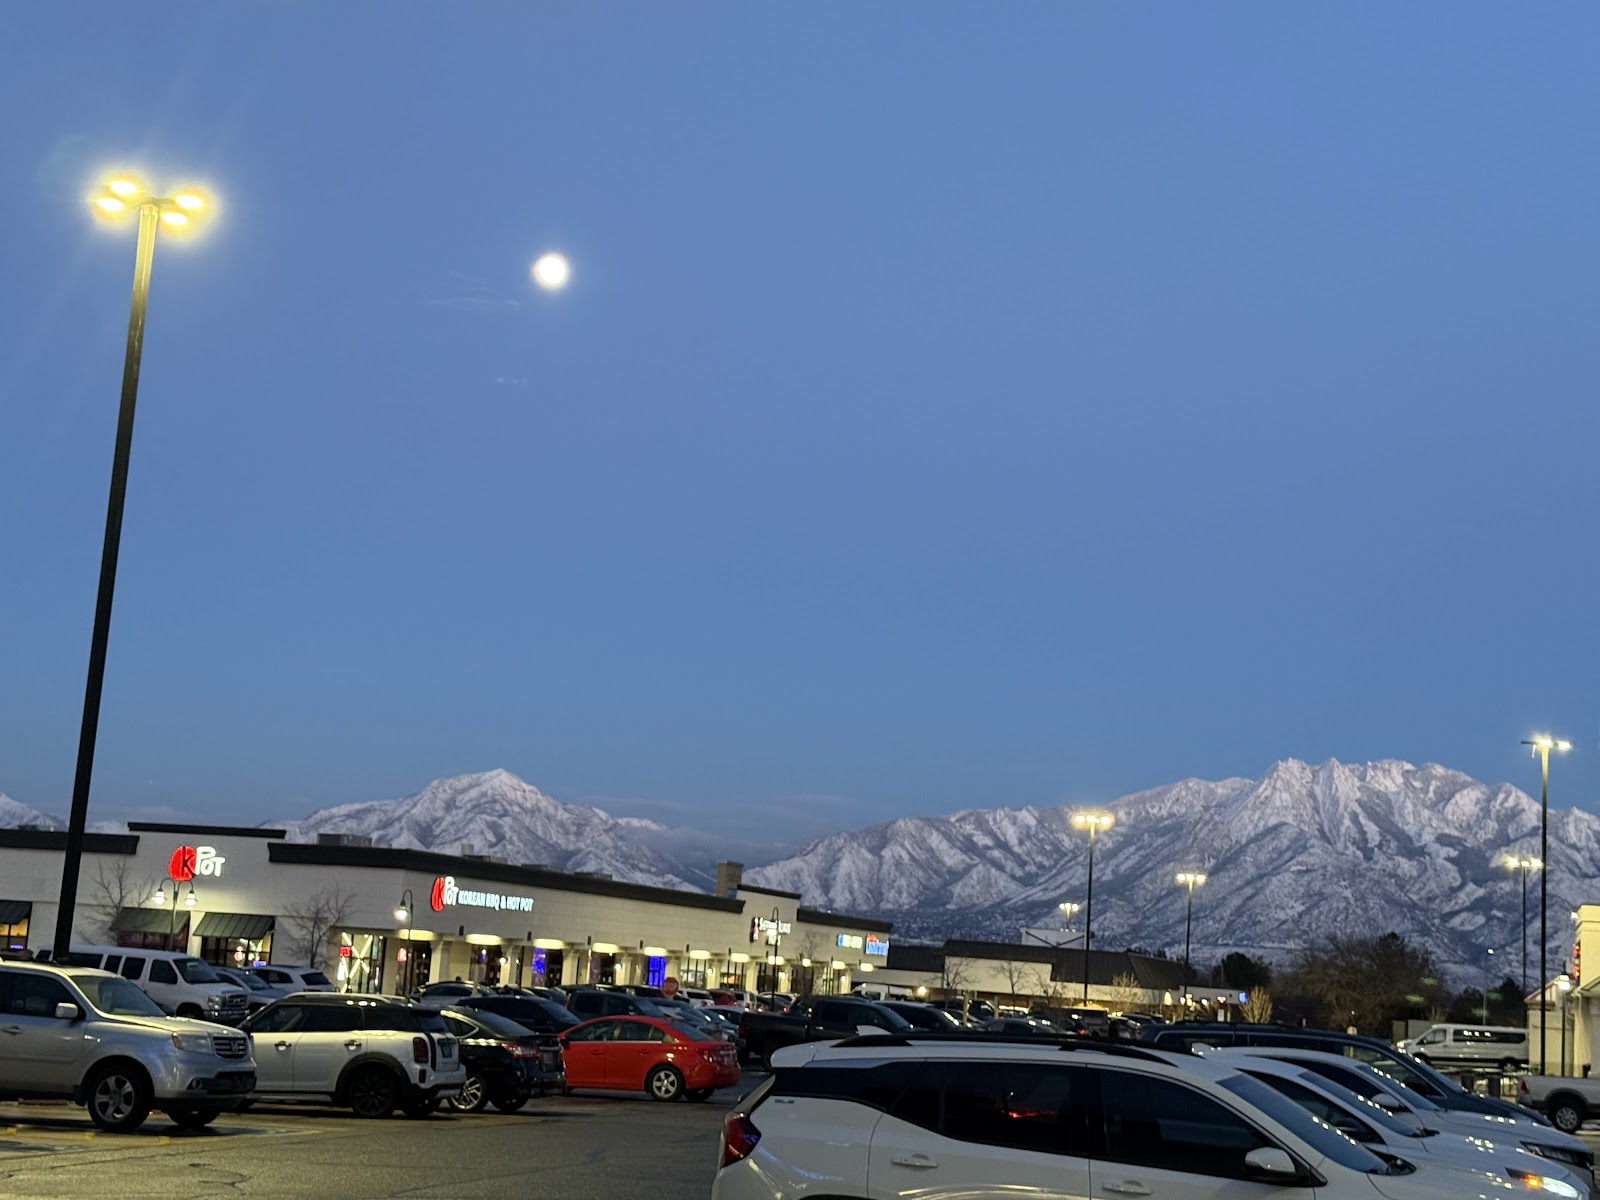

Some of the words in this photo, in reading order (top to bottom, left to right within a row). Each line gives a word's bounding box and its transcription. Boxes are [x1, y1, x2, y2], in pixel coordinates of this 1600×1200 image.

[458, 890, 486, 906] KOREAN
[486, 893, 500, 911] BBQ
[500, 895, 507, 909] &
[507, 896, 520, 911] HOT
[520, 897, 534, 912] POT
